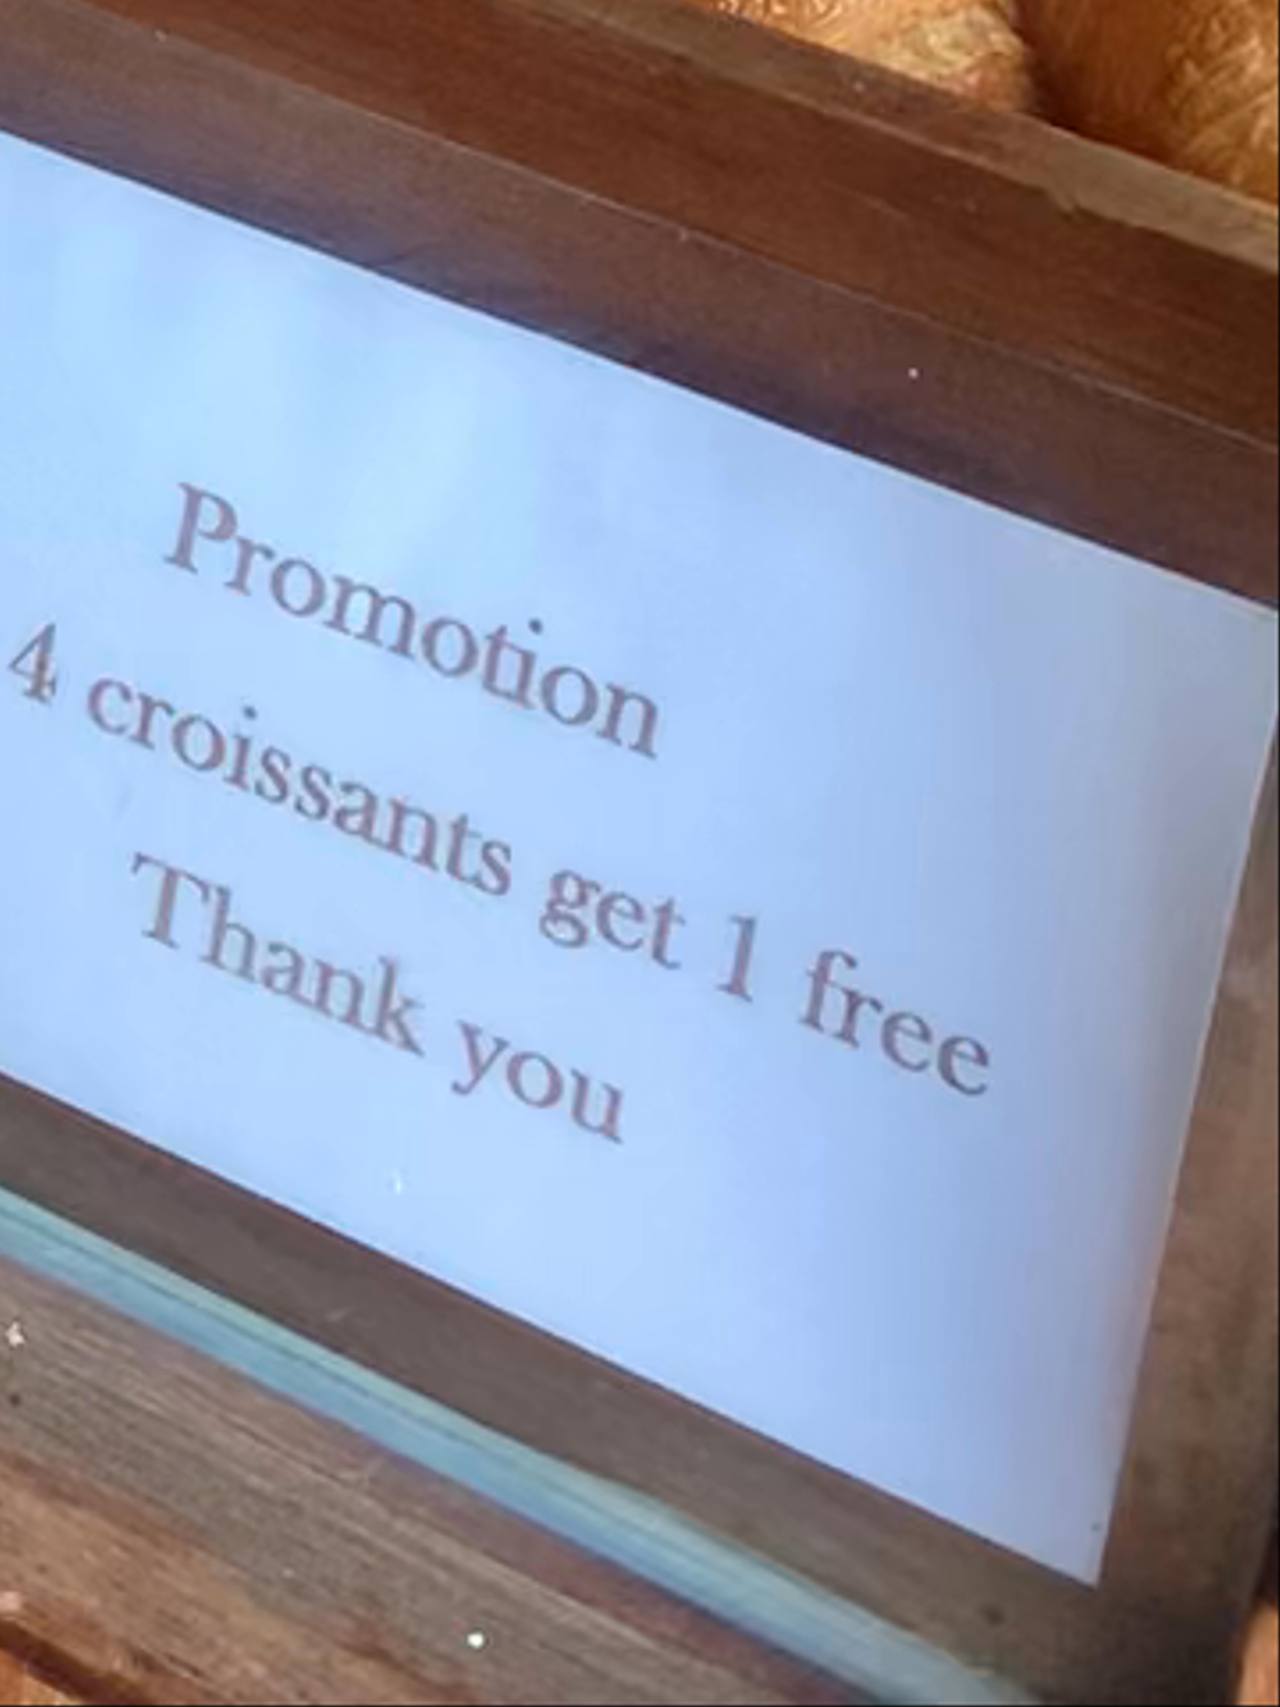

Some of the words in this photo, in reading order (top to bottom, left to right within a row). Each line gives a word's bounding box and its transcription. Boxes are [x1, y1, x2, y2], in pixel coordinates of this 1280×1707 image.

[163, 482, 658, 760] Promotion
[8, 623, 57, 704] 4
[87, 679, 511, 896] croissants
[539, 870, 686, 970] get
[717, 915, 757, 1004] 1
[800, 949, 989, 1096] free
[131, 852, 425, 1057] Thank
[451, 1020, 623, 1144] you
